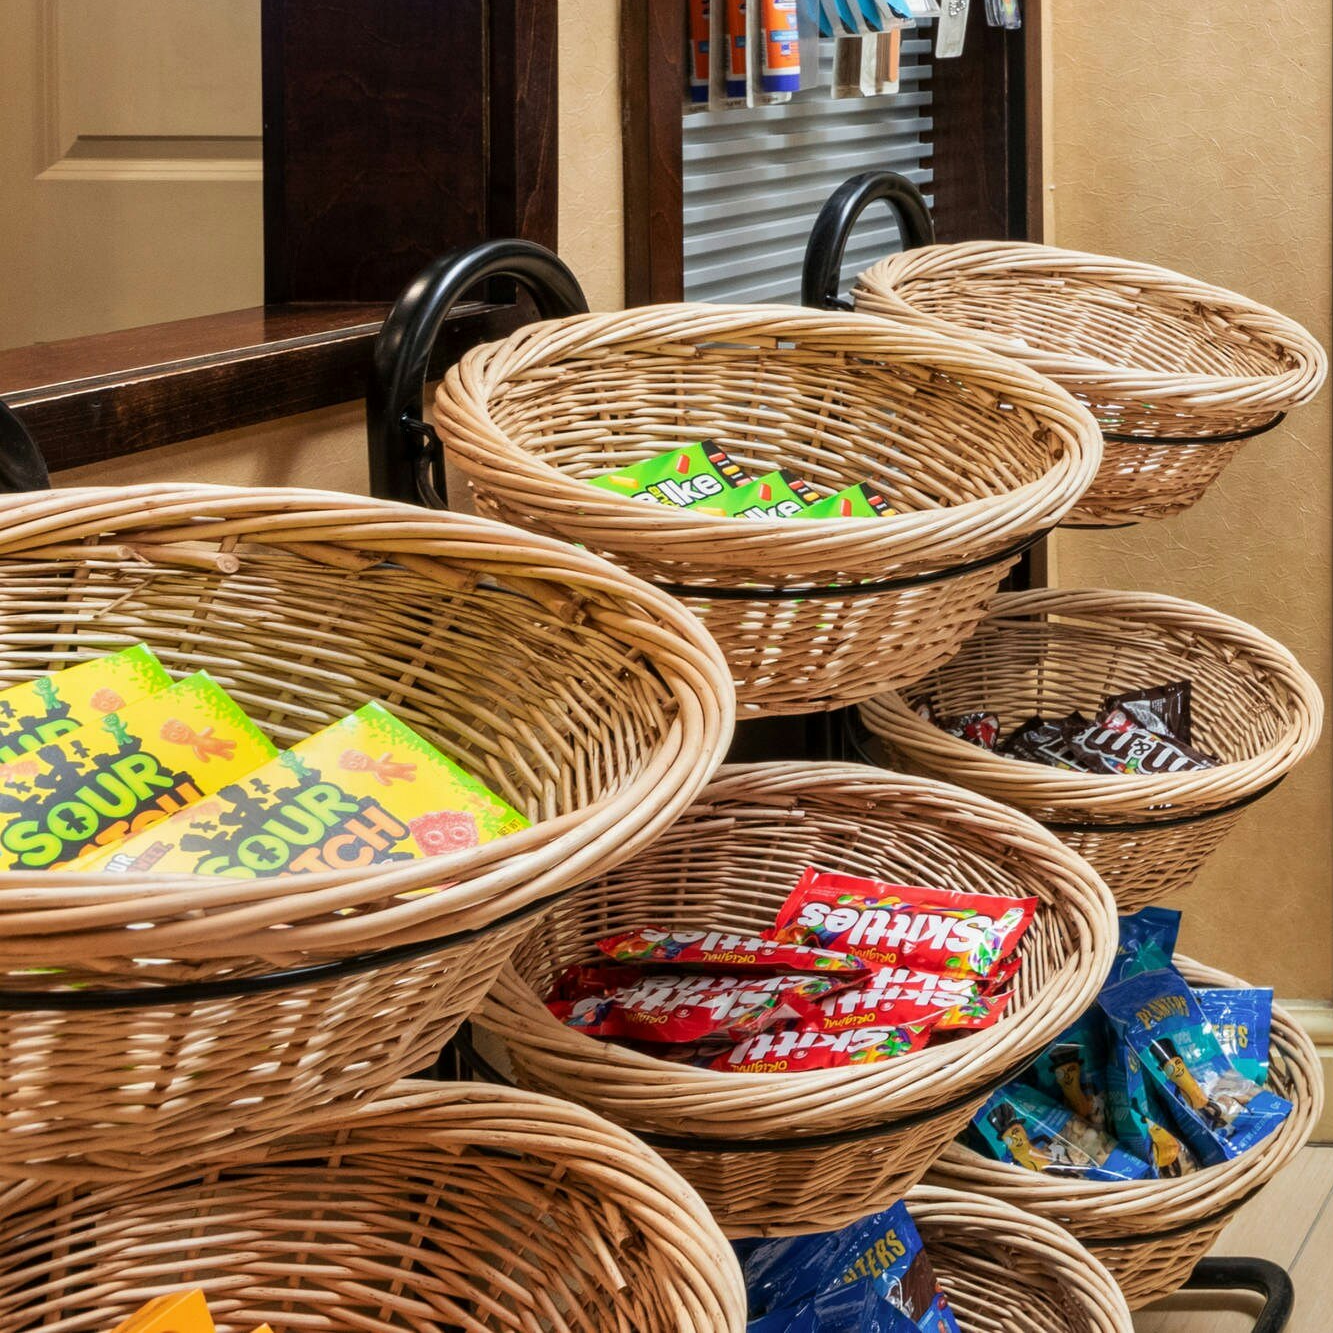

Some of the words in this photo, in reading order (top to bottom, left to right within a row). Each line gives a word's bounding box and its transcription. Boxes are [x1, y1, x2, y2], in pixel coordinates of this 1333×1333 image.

[2, 750, 174, 867] SOUR
[797, 901, 986, 953] Skittles
[703, 951, 757, 964] ORIGINAL
[850, 945, 897, 964] ORIGINAL
[824, 1013, 876, 1030] ORIGINAL
[1135, 995, 1190, 1030] PLANTERS
